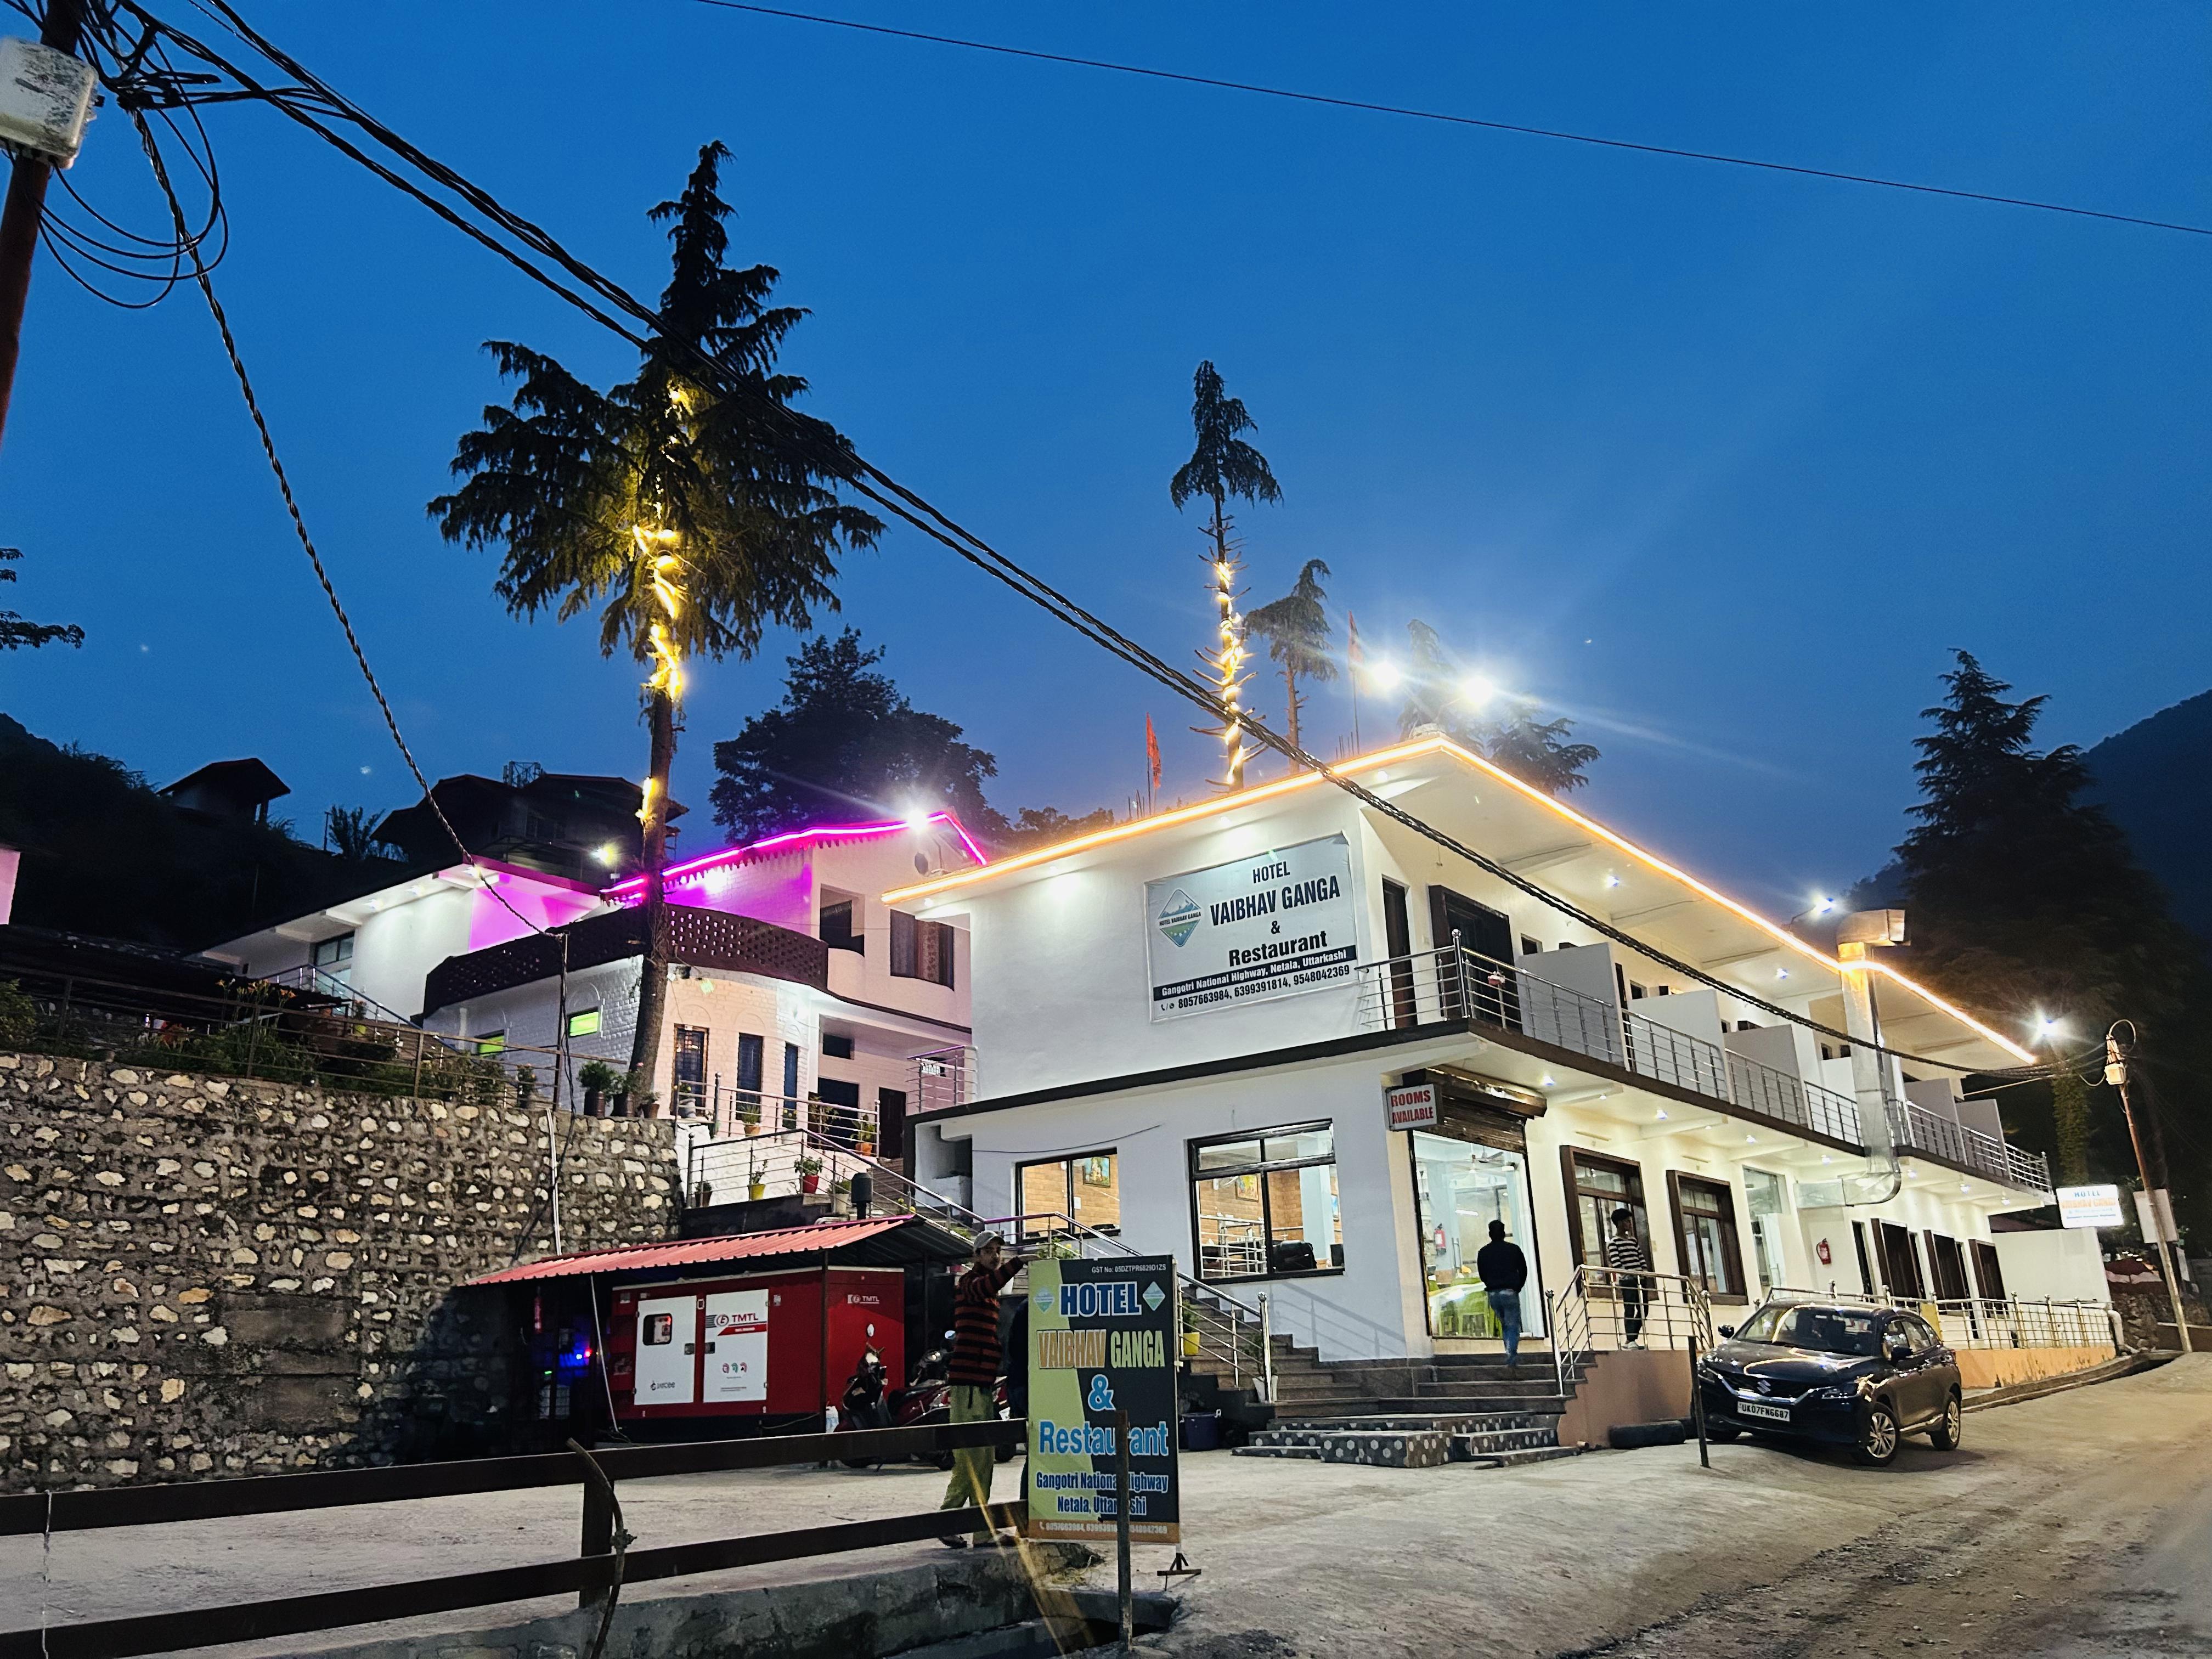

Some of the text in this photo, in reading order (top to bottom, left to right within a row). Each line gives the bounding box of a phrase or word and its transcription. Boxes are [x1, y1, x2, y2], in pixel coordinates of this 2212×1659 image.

[1252, 861, 1290, 883] HOTEL
[1210, 875, 1340, 926] VAIBHAV GANGA
[1271, 921, 1280, 934] &
[1229, 930, 1327, 967] Restaurant
[1161, 949, 1347, 996] Gangotri National Highway, Netala, Uttarkashi
[1178, 964, 1350, 1008] 8057663984, 6399391814, 9548042369
[1391, 1090, 1431, 1107] ROOMS
[1392, 1107, 1434, 1124] AVAILABLE
[1059, 1282, 1142, 1317] HOTEL
[731, 1313, 758, 1322] TMTL
[1037, 1329, 1165, 1369] VAIBHAV GANGA
[1088, 1374, 1116, 1411] &
[1039, 1419, 1169, 1456] Restauant
[1036, 1471, 1078, 1490] Gangotri
[1080, 1471, 1117, 1490] Nationa
[1057, 1496, 1091, 1514] Netala,
